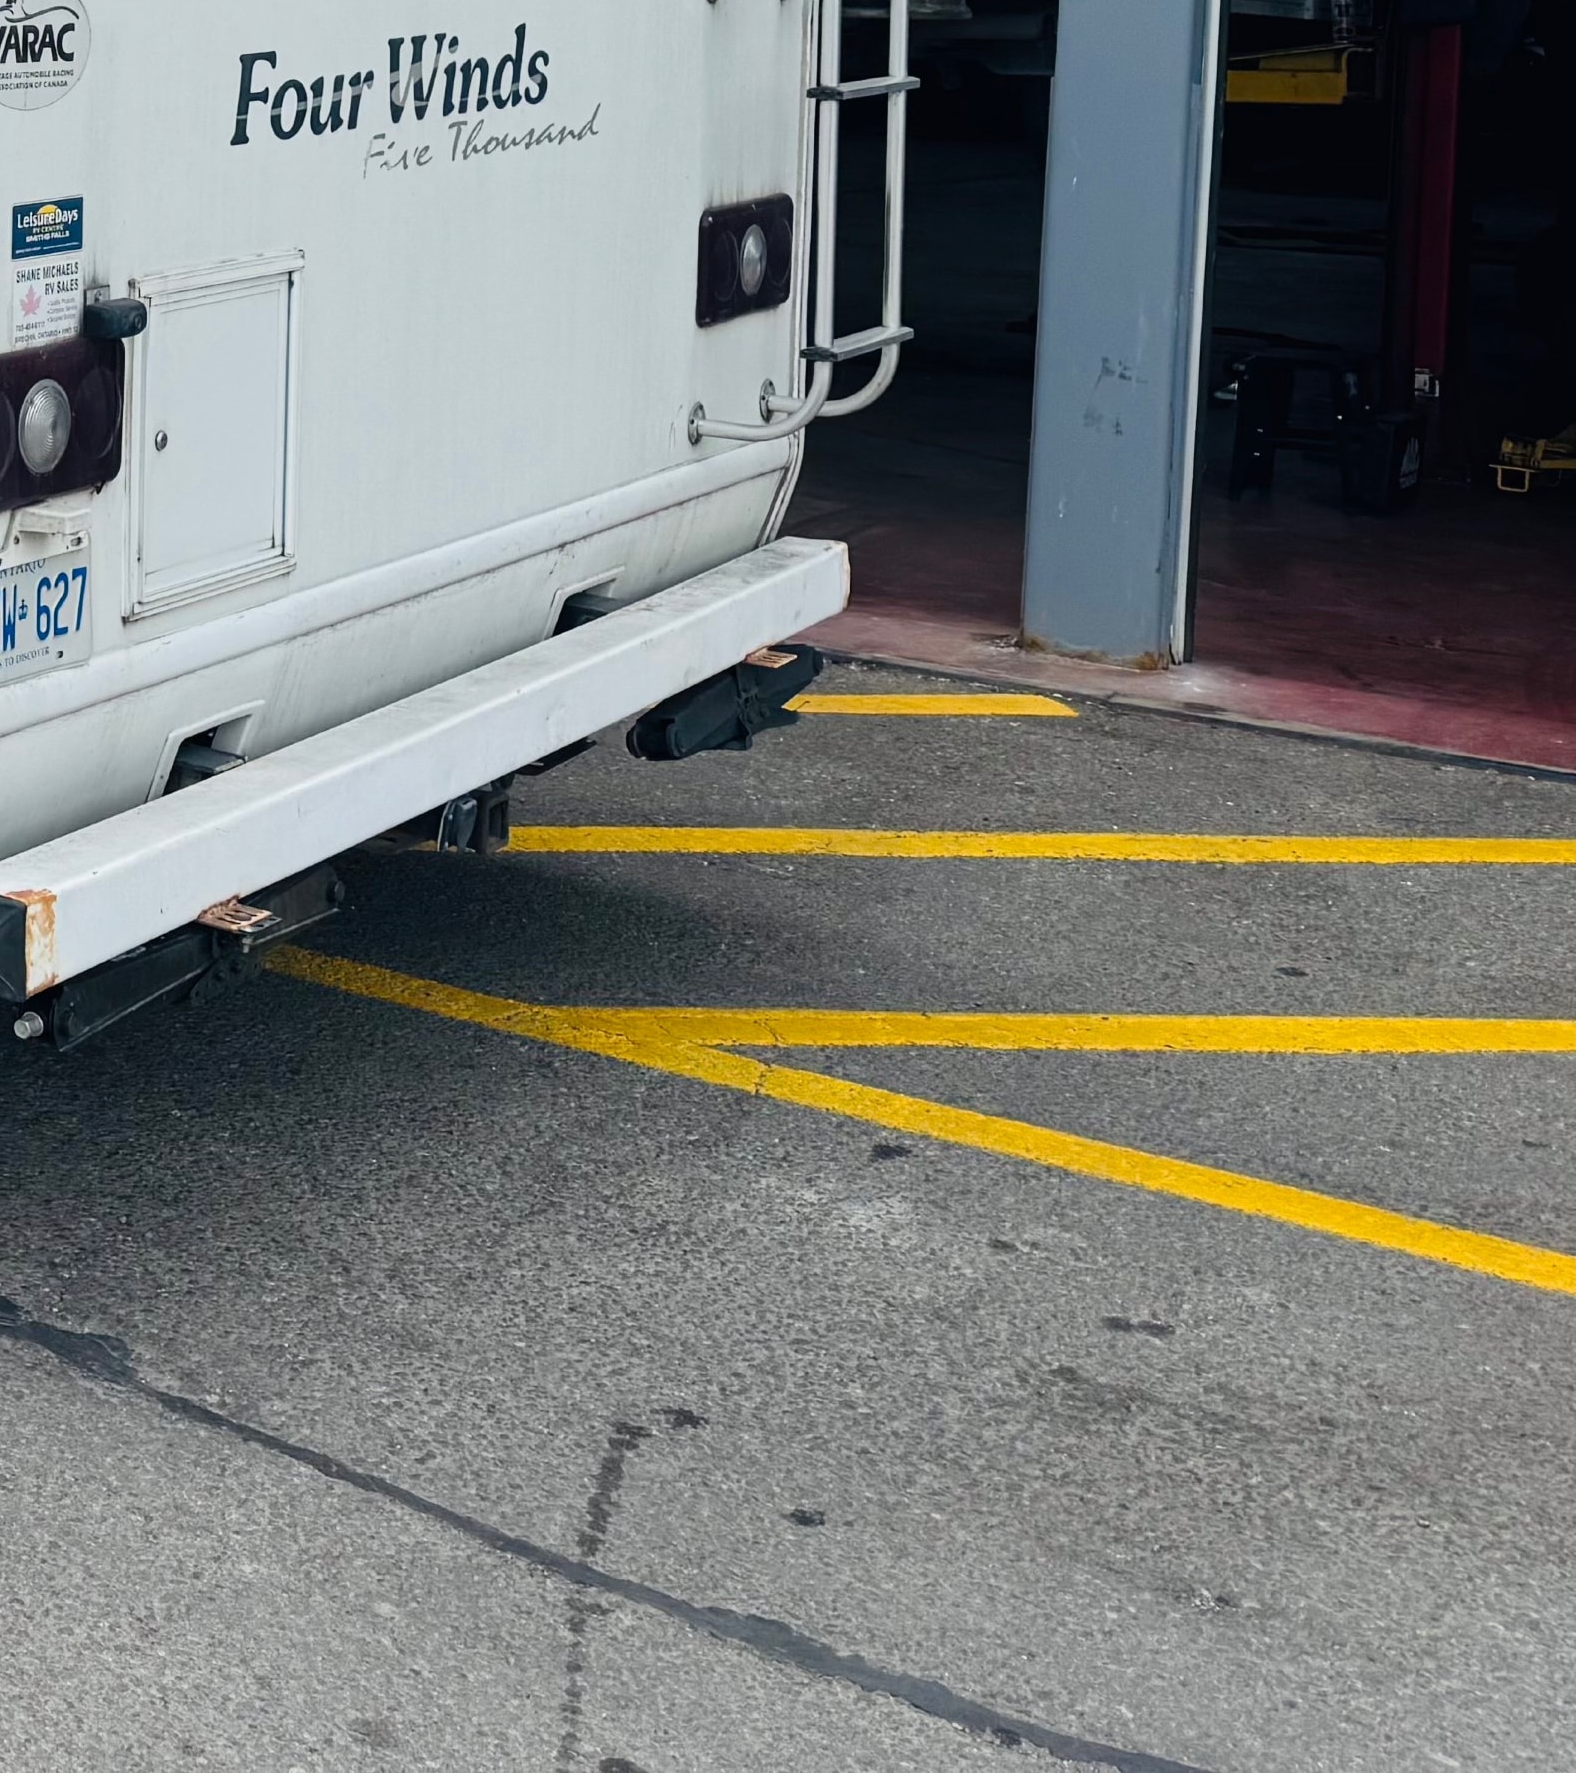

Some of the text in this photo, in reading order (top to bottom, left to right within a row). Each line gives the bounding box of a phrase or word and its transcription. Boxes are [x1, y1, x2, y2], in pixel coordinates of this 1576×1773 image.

[14, 70, 51, 79] AUTOMOBILE
[43, 80, 68, 88] CANADA
[230, 22, 549, 146] Four Winds
[363, 102, 601, 180] Five Thousand
[16, 262, 79, 284] SHANE MICHAELS
[56, 278, 79, 294] SALES
[36, 566, 88, 641] 627
